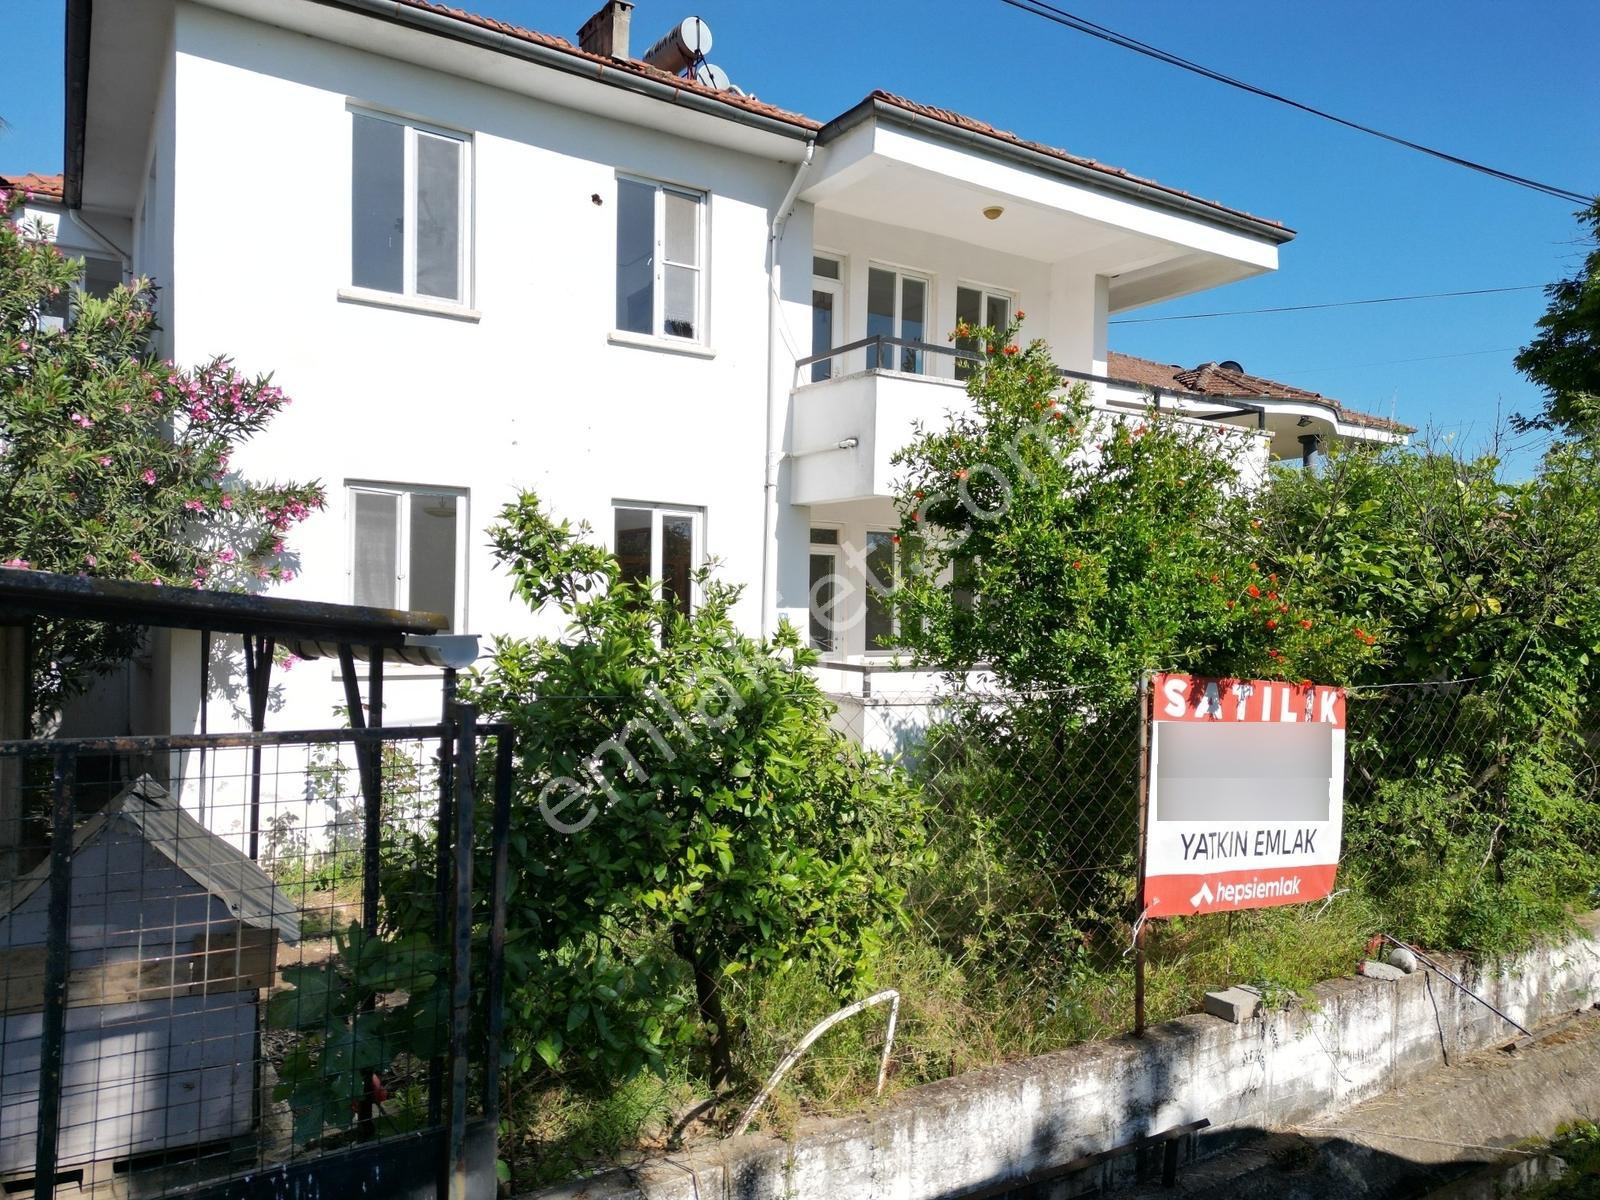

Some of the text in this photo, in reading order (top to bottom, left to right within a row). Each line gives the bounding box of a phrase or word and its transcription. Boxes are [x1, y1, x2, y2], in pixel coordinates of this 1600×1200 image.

[1163, 678, 1338, 725] SATILIK
[1180, 828, 1318, 861] YATKIN EMLAK
[1215, 875, 1301, 905] hepsiemlak
